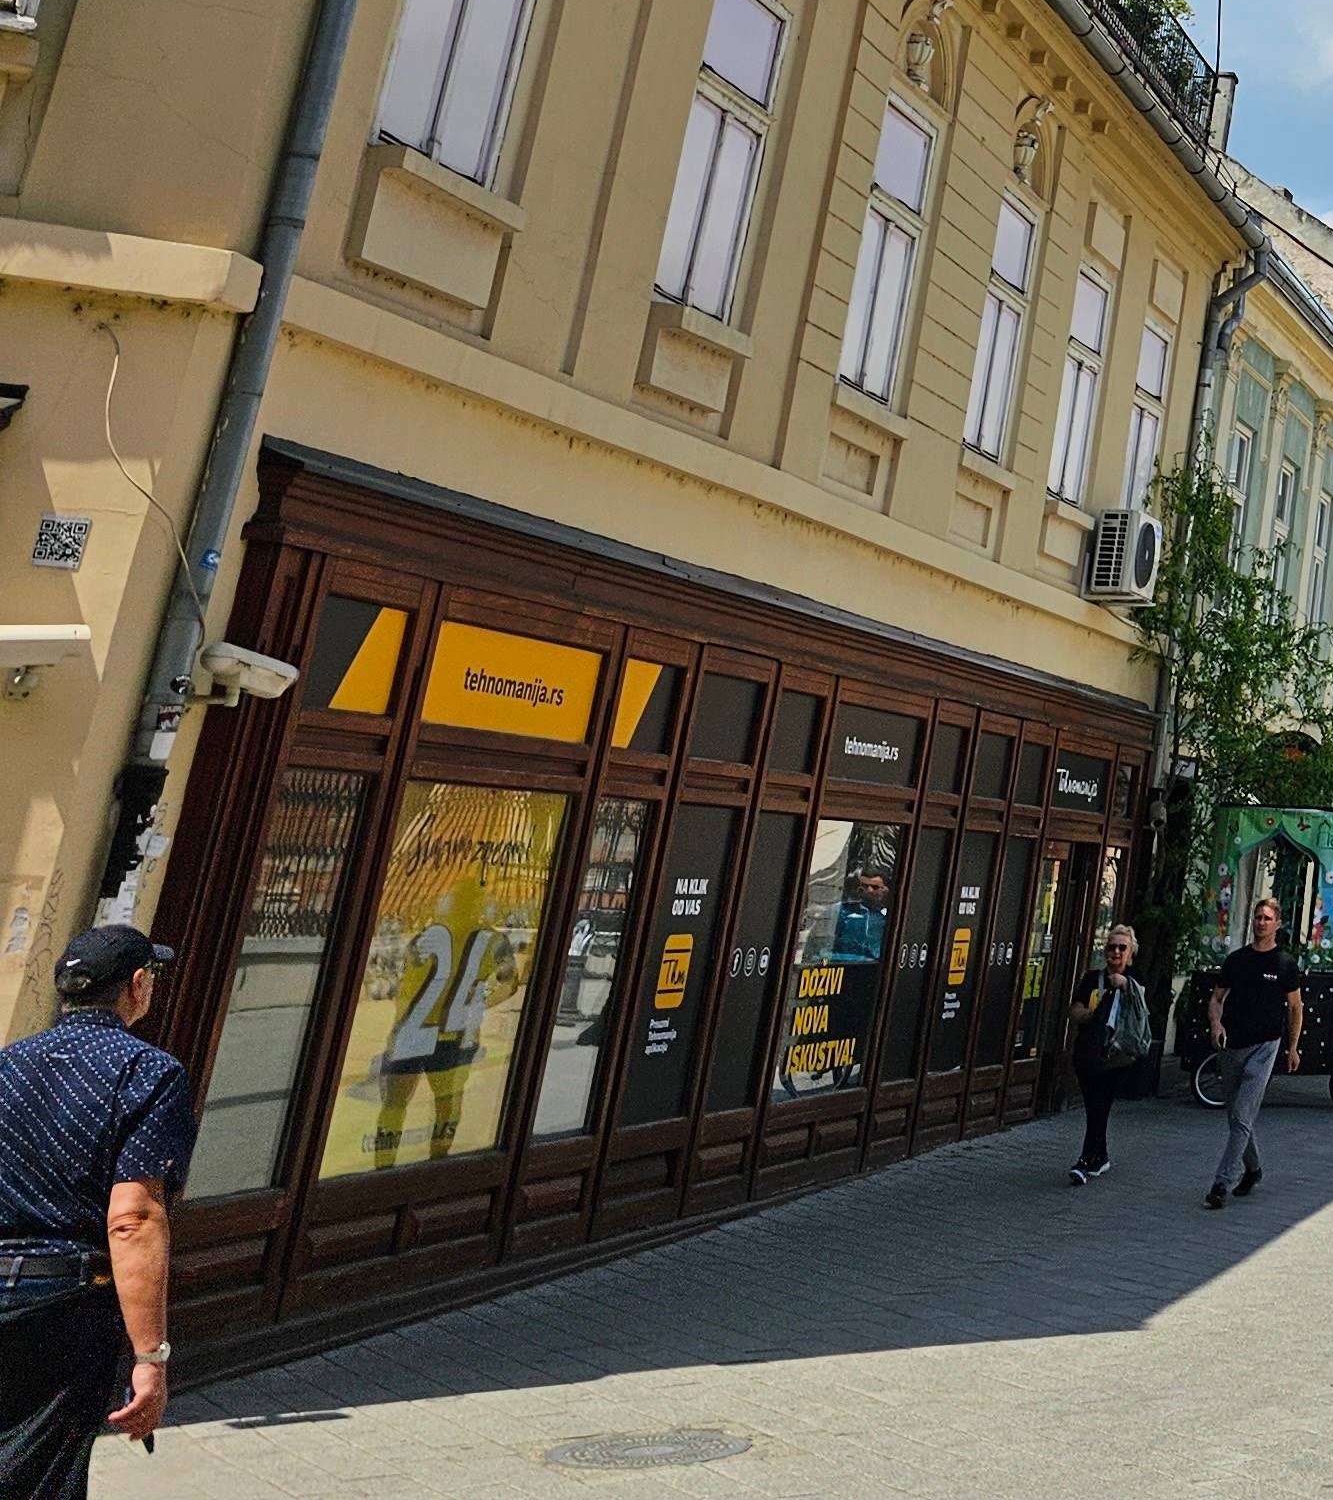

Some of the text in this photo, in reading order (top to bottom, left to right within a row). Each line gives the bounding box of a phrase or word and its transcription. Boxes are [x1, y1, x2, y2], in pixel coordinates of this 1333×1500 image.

[463, 667, 565, 708] tehnomanija.rs
[675, 878, 709, 895] NA KLIK
[672, 899, 702, 916] OD VAS
[798, 957, 845, 998] DOŽIVI
[791, 1004, 829, 1037] NOVA
[785, 1037, 857, 1076] ISKUSTVA!
